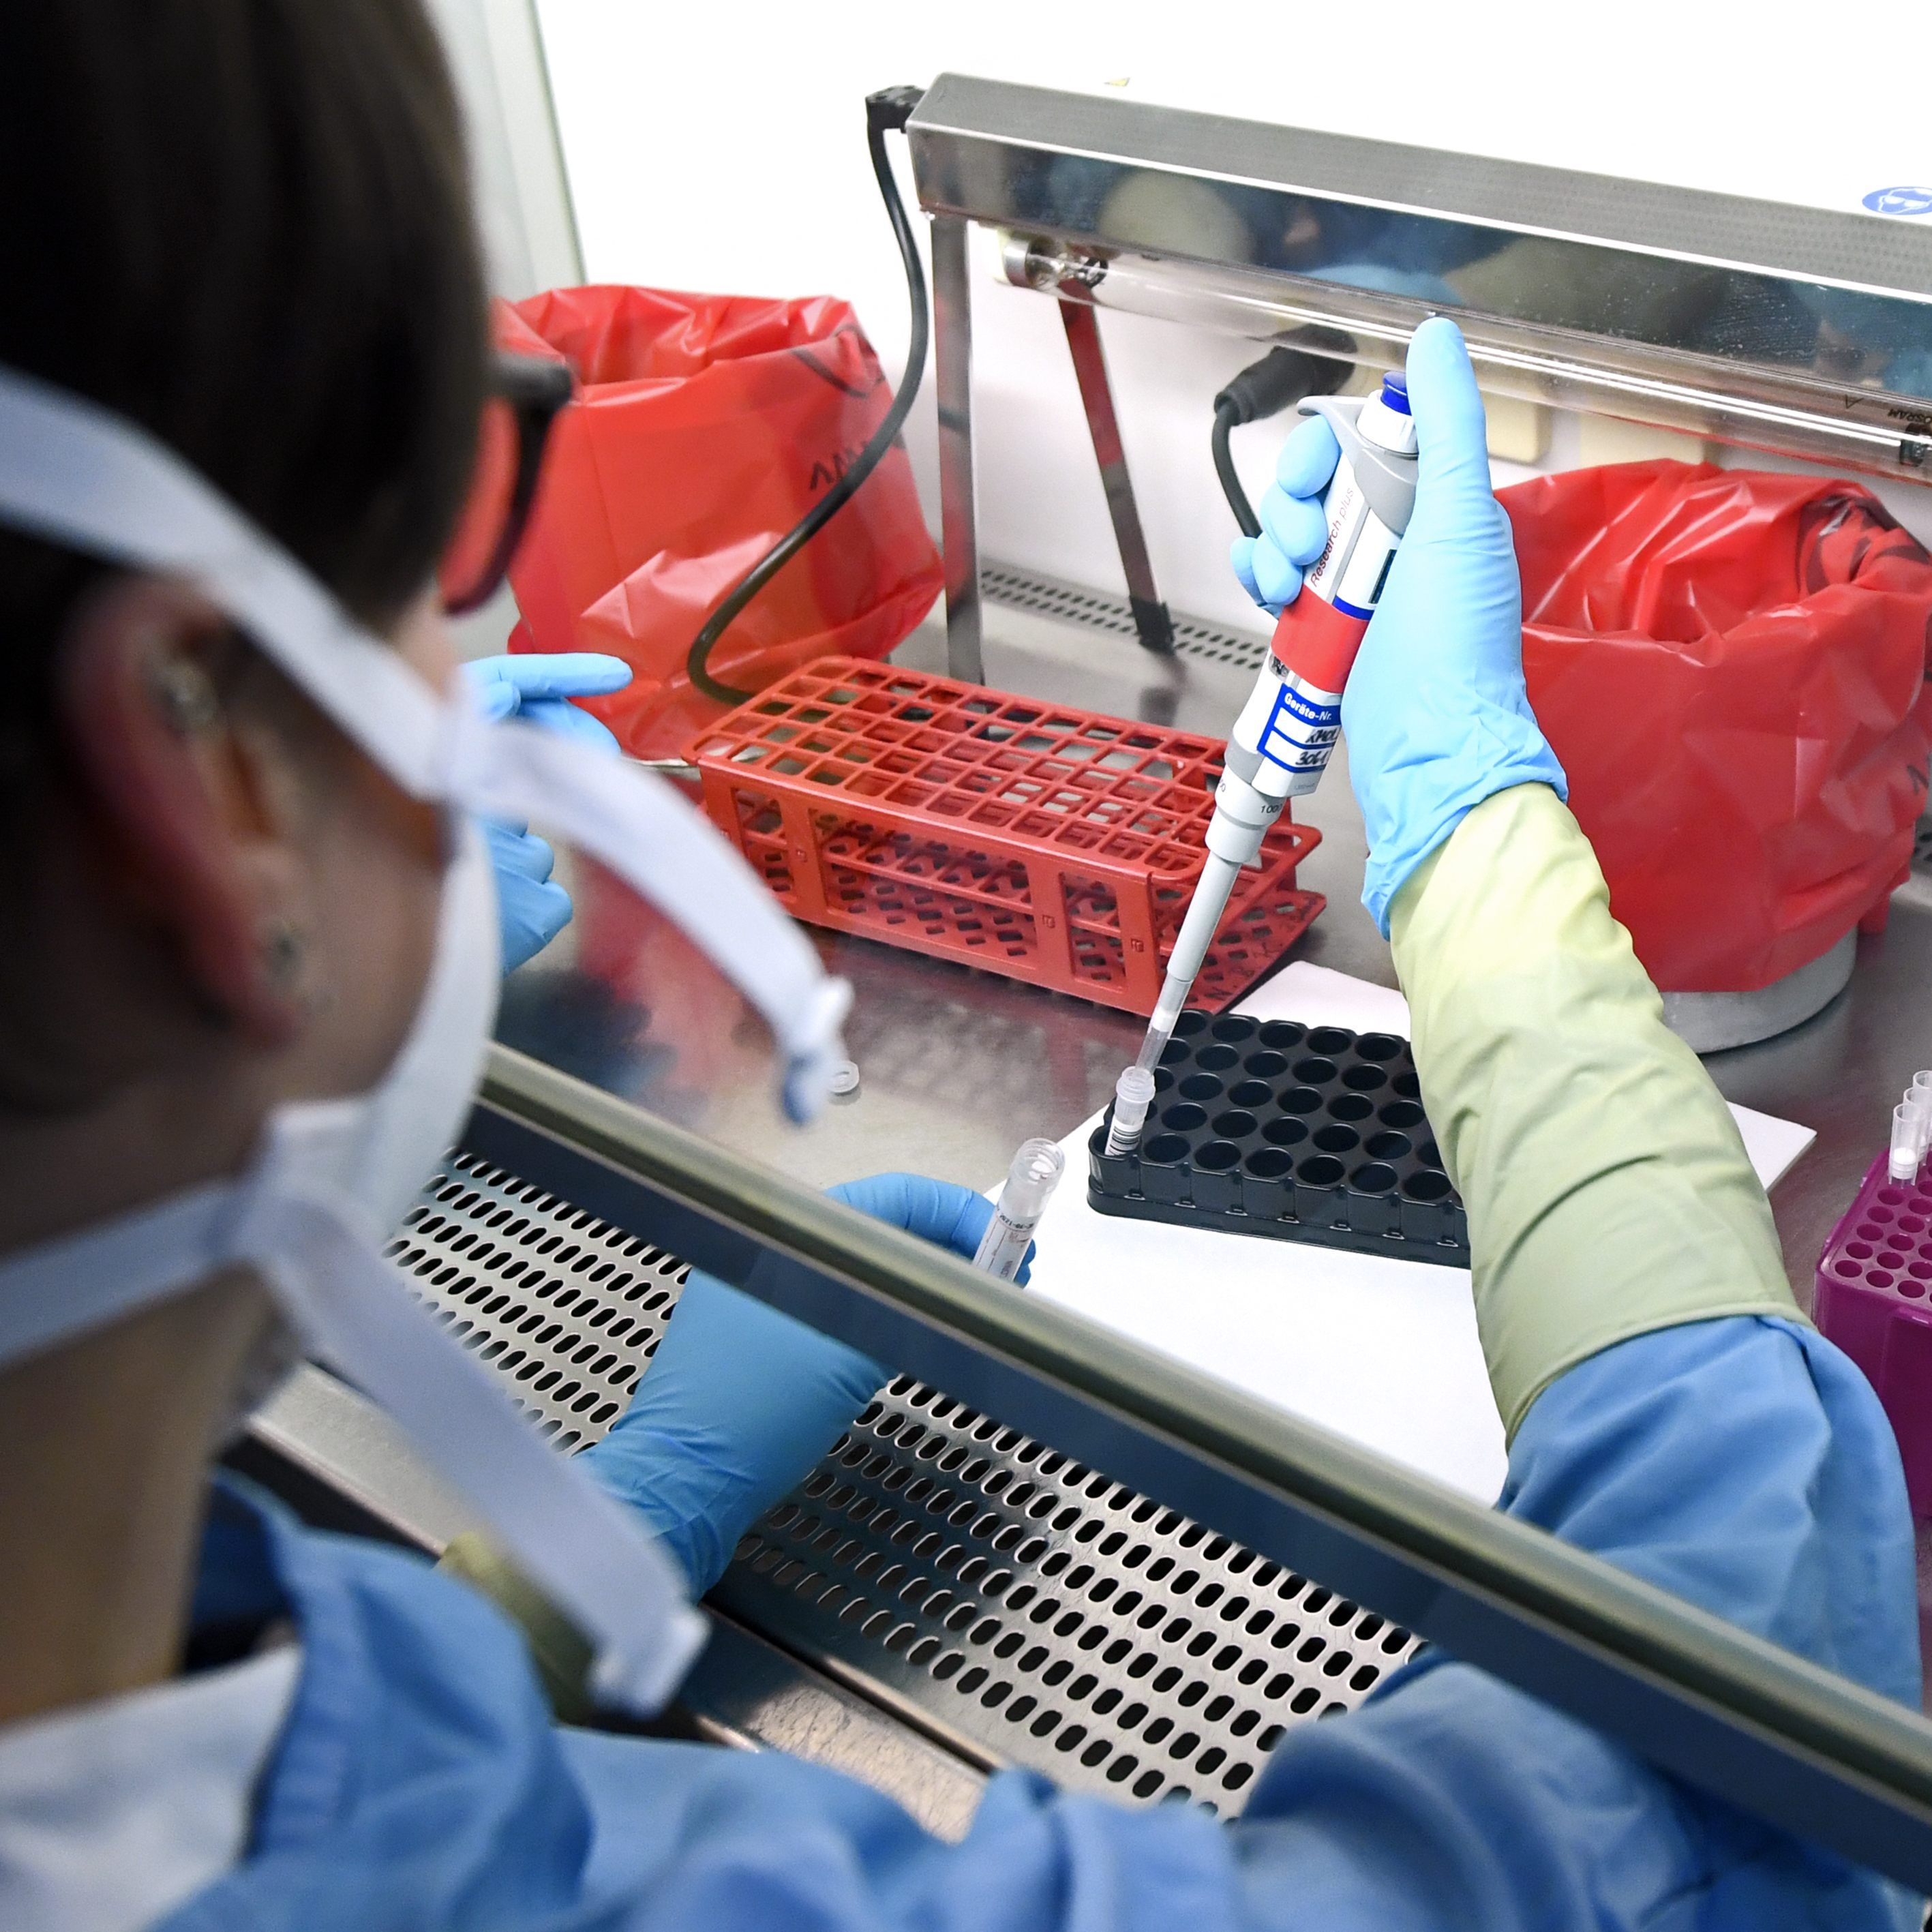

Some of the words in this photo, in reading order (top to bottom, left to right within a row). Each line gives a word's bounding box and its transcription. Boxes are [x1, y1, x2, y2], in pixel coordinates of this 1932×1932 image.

[1887, 409, 1932, 423] OSRAM
[1310, 520, 1342, 587] Research
[1339, 487, 1354, 521] plus
[1284, 693, 1332, 721] Geräte-Nr.
